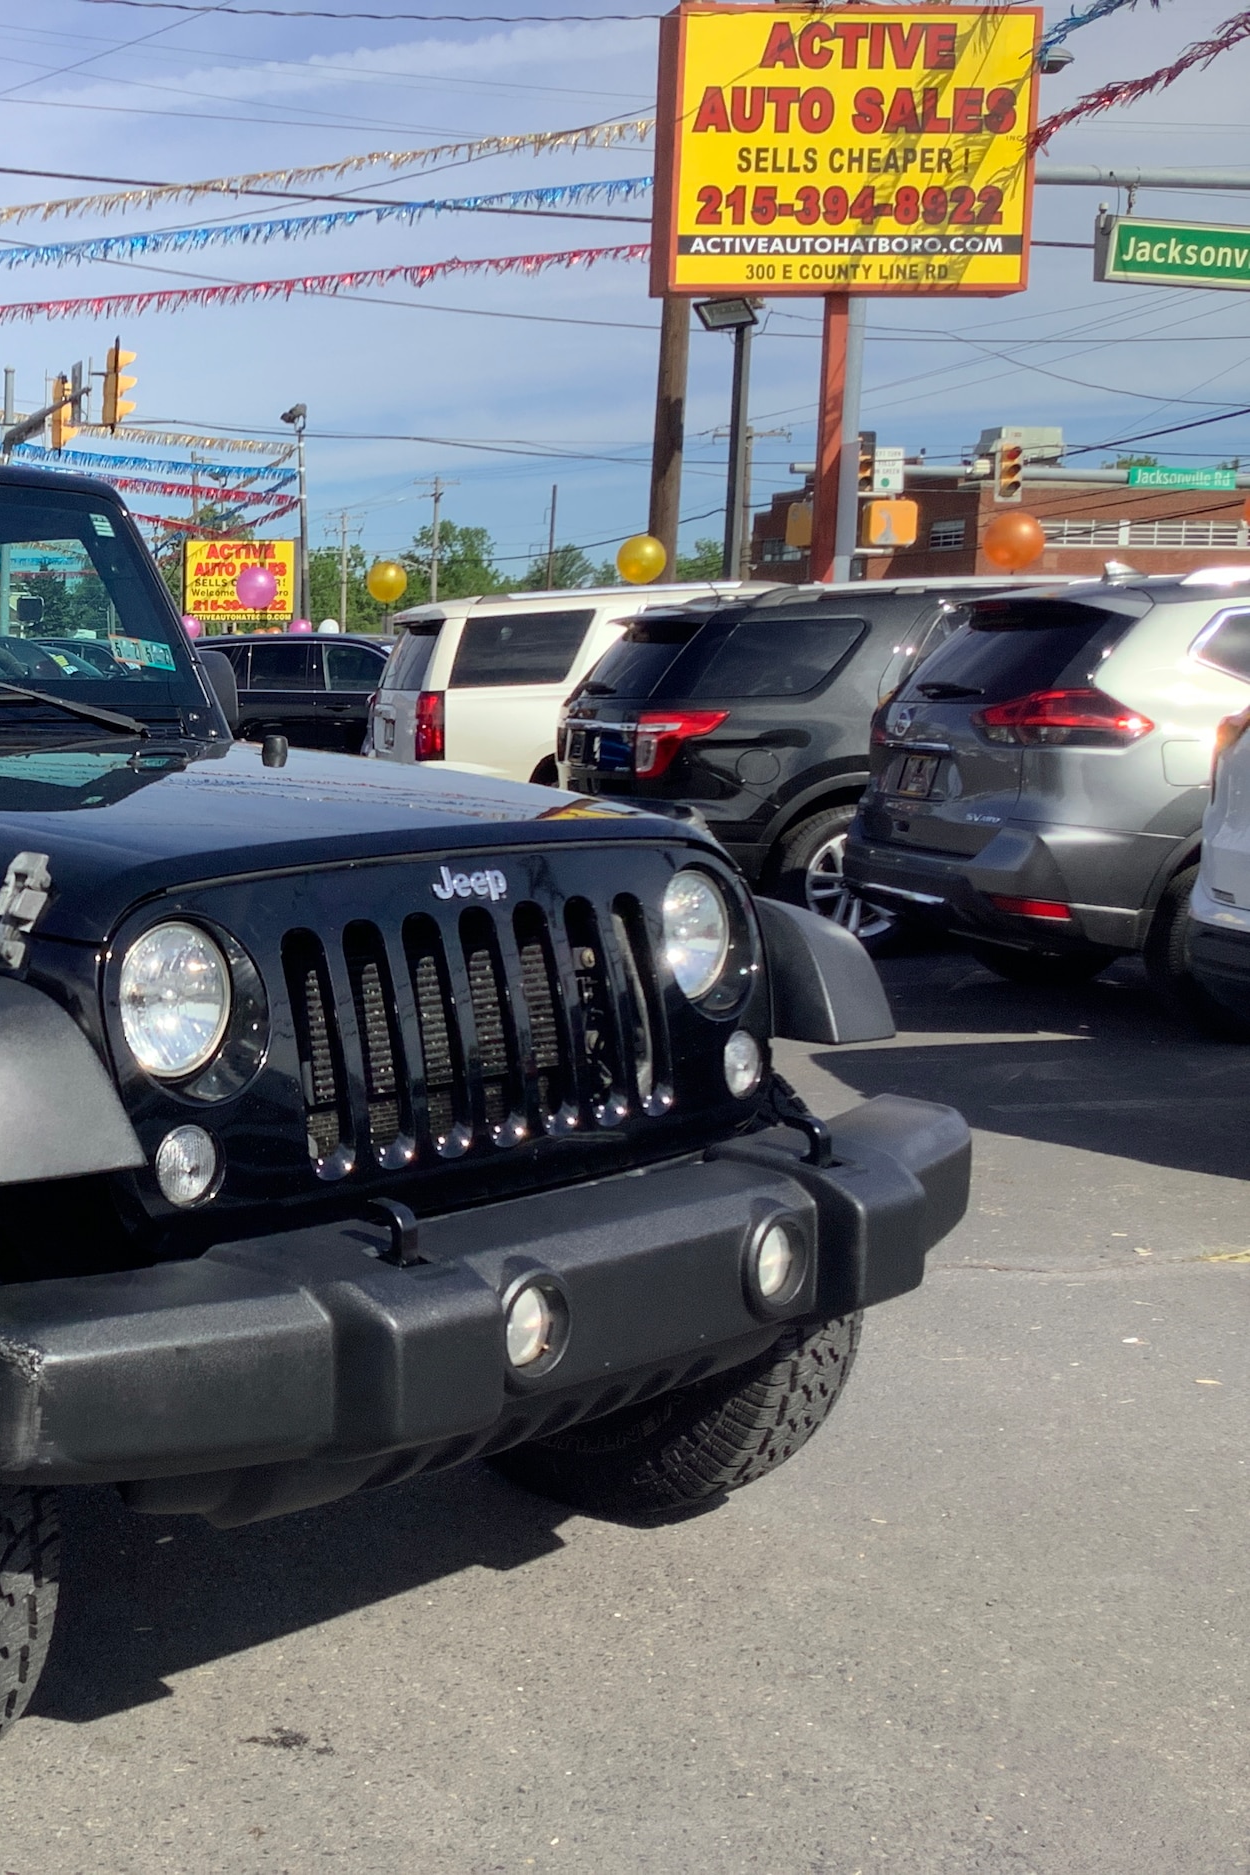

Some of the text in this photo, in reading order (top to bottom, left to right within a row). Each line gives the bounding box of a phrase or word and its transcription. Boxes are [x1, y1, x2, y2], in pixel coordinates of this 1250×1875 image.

[760, 21, 957, 70] ACTIVE
[692, 86, 1017, 134] AUTO SALES
[737, 147, 818, 173] SELLS
[829, 147, 953, 173] CHEAPER
[695, 185, 1003, 226] 215-394-8922
[689, 237, 1003, 254] ACTIVEAUTOHATBORO.COM
[1122, 236, 1250, 269] Jacksonv
[745, 264, 948, 281] 300 E COUNTY LINE RD
[1135, 468, 1230, 486] Jacksonville Rd
[206, 543, 276, 560] ACTIVE
[194, 562, 237, 577] AUTO
[195, 578, 228, 587] SELLS
[191, 588, 235, 597] Welcome
[432, 866, 507, 901] Jeep
